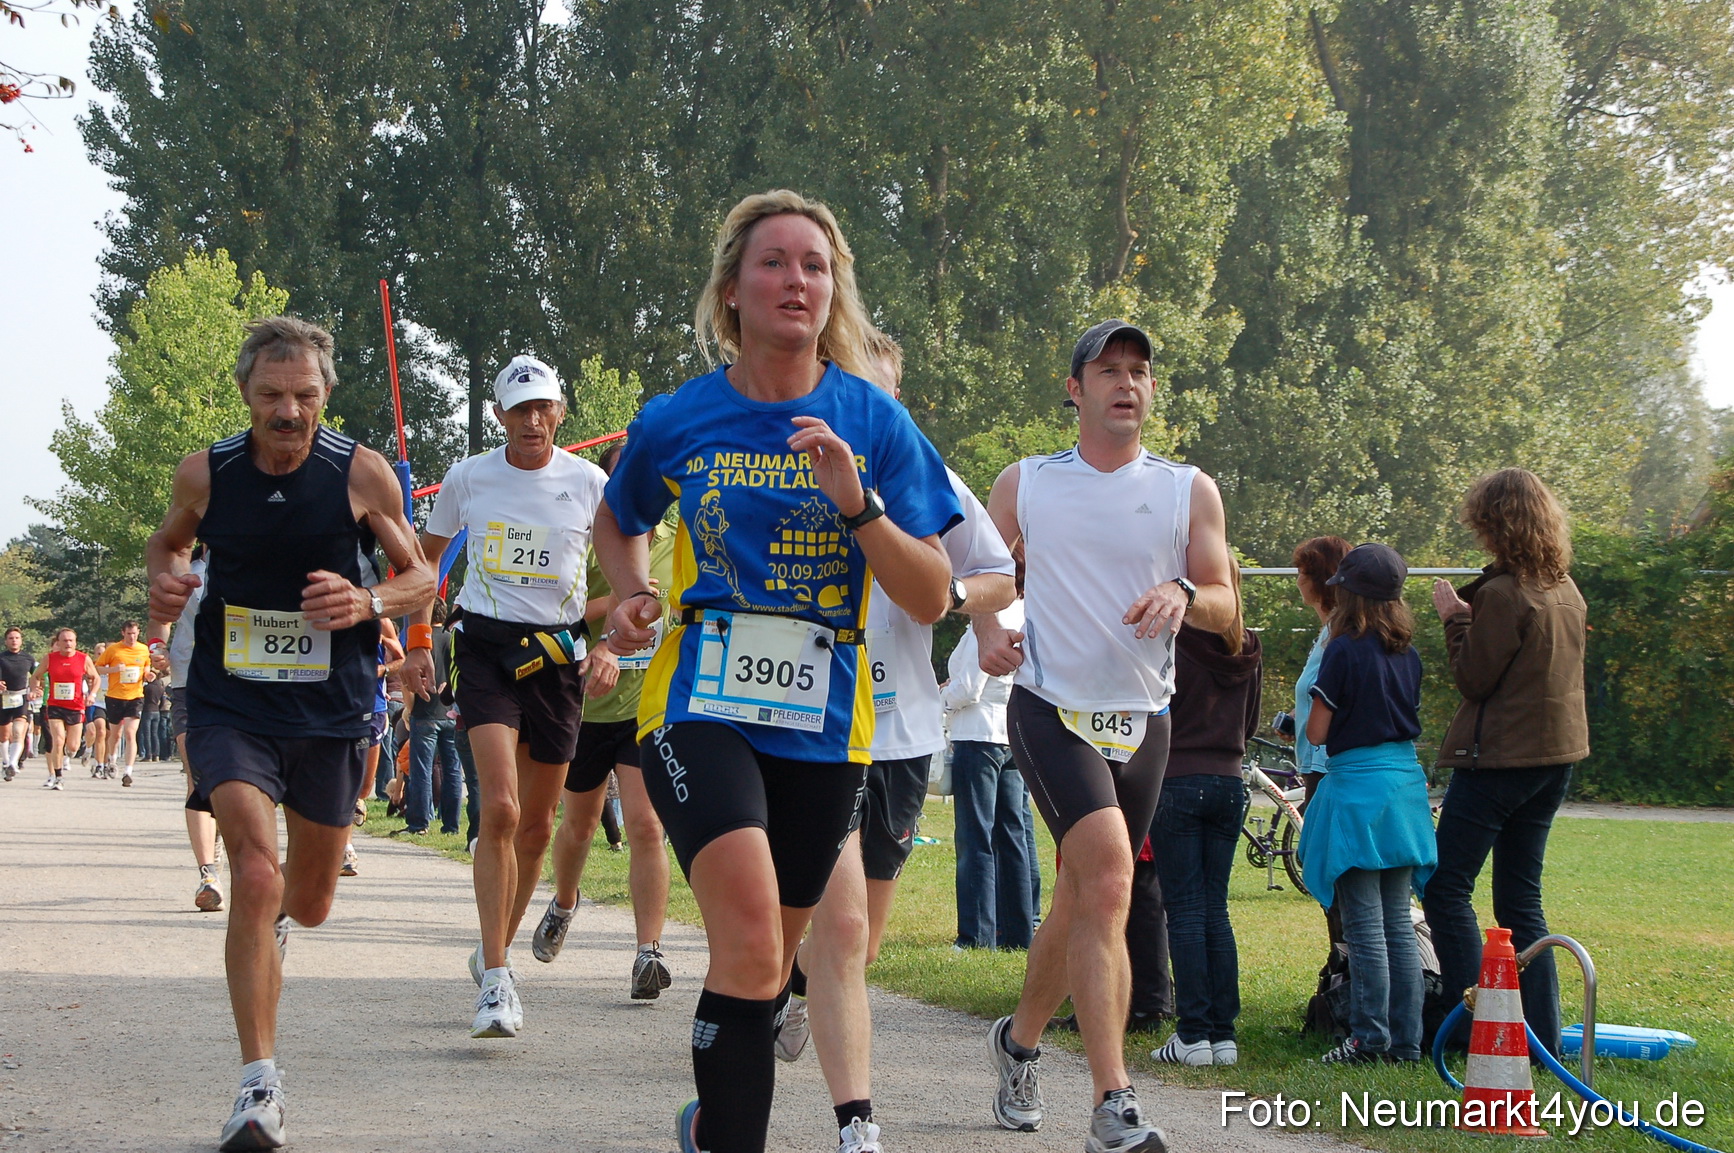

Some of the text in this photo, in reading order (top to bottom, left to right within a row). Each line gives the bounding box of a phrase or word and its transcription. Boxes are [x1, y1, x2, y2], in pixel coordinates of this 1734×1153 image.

[714, 452, 867, 473] NEUMARR
[707, 468, 820, 489] STADTLAU
[507, 527, 532, 541] Gerd
[488, 544, 493, 553] A
[512, 547, 550, 567] 215
[768, 560, 849, 580] 20.09.2009
[253, 615, 299, 629] Hubert
[230, 631, 237, 642] B
[264, 634, 313, 655] 820
[735, 655, 815, 691] 3905
[773, 709, 822, 724] PFLEIDERER
[1091, 712, 1133, 737] 645
[659, 742, 689, 803] odlo
